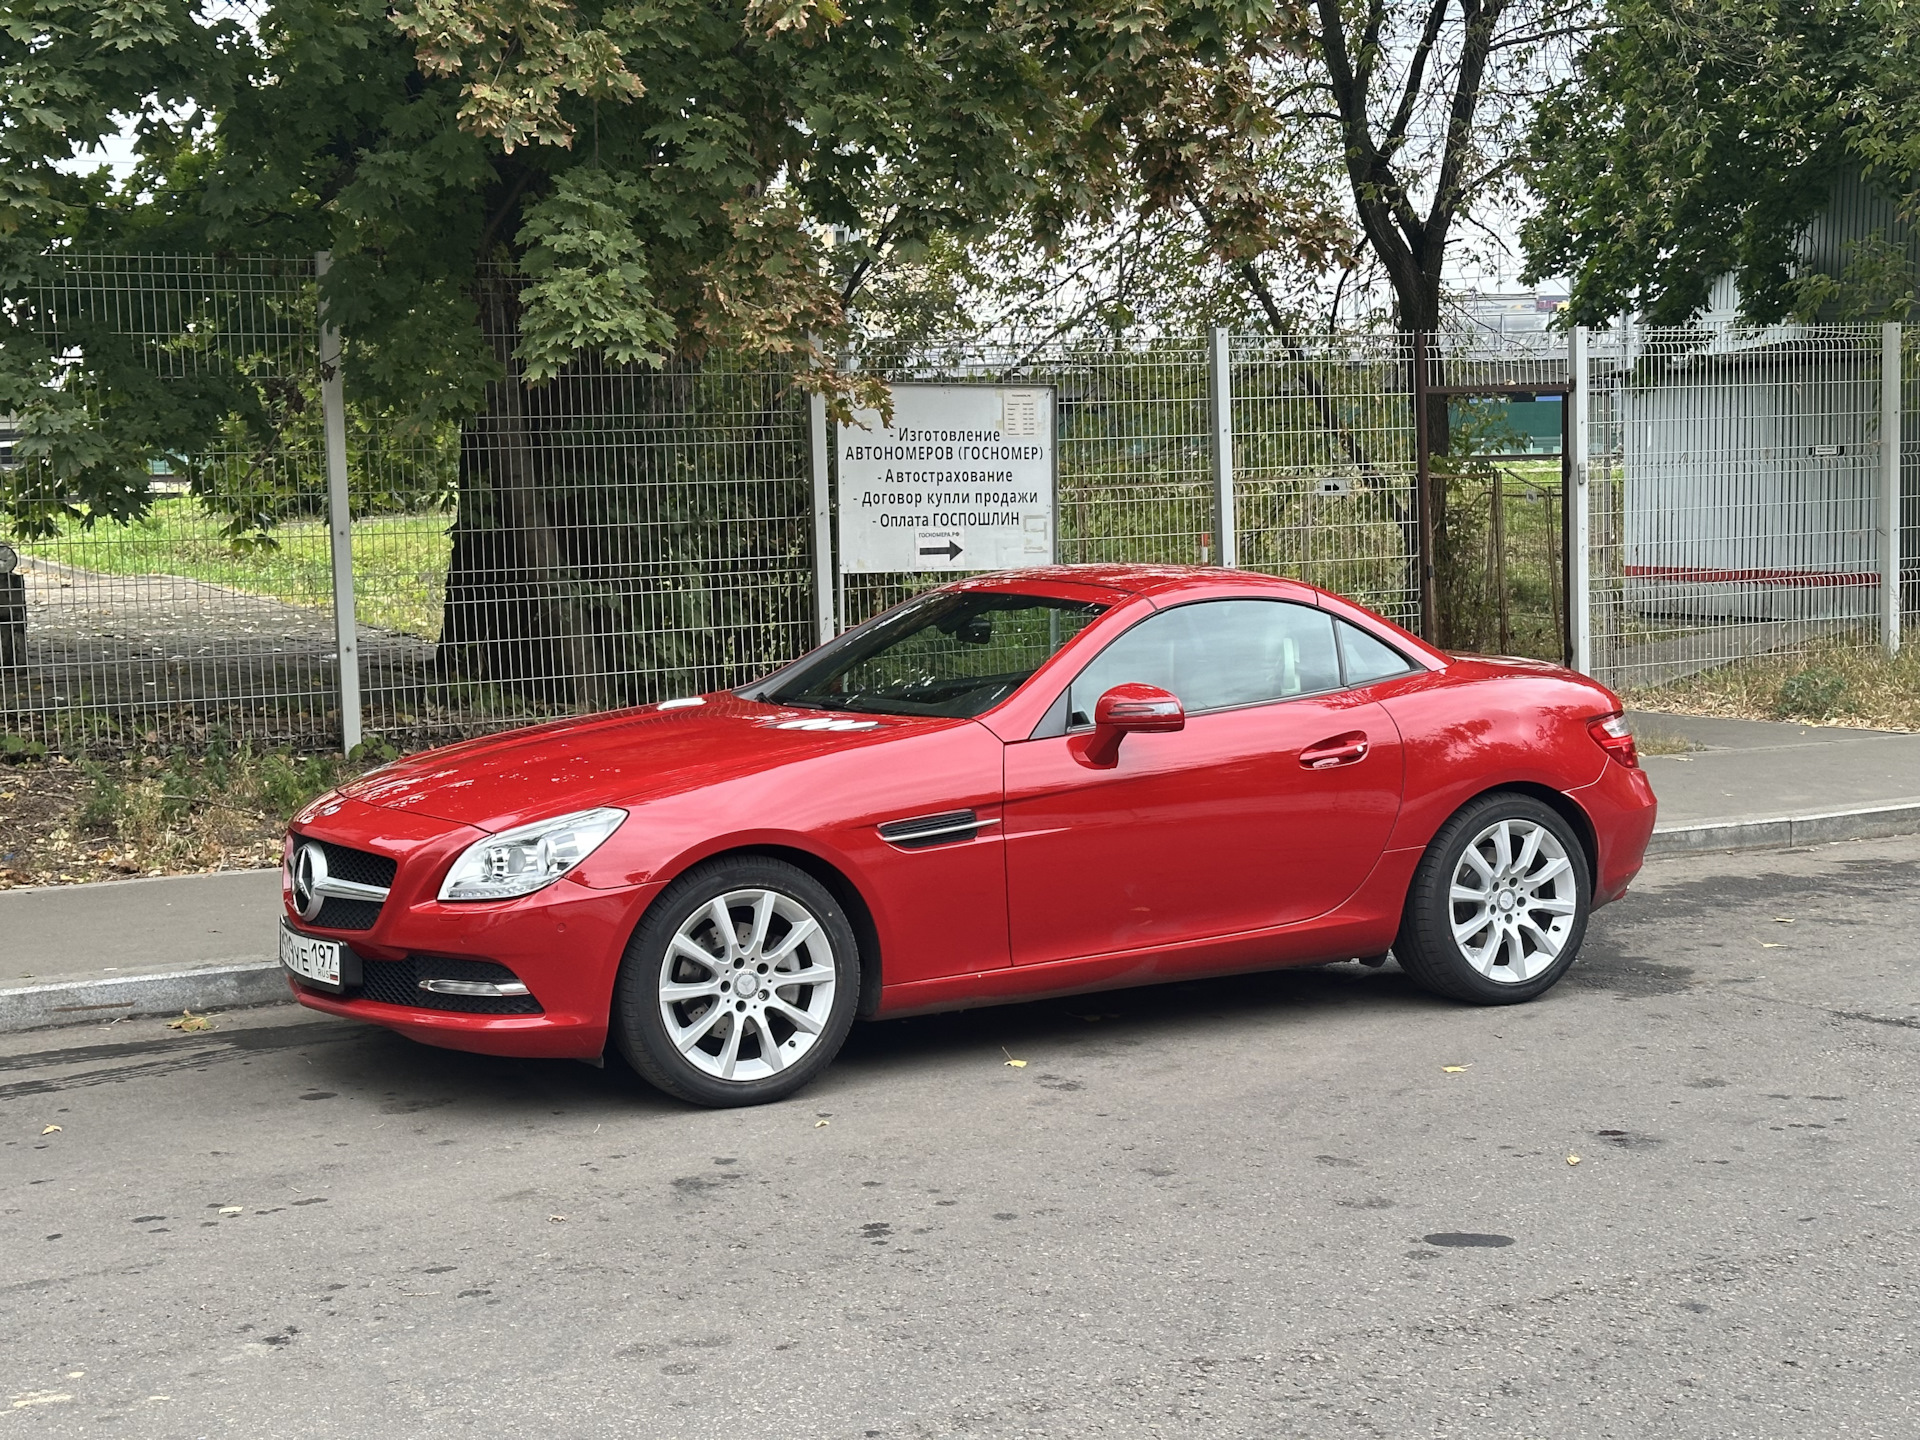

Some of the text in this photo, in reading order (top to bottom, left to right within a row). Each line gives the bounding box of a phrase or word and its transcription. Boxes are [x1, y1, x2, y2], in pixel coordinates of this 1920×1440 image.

[898, 427, 1001, 442] Изготовление
[845, 445, 1043, 461] АВТОНОМЕРОВ (ГОСНОМЕР)
[885, 468, 1013, 486] Автострахование
[862, 491, 922, 508] Договор
[927, 492, 970, 508] купли
[975, 491, 1038, 508] продажи
[880, 513, 929, 528] Оплата
[933, 511, 1020, 527] ГОСПОШЛИН
[311, 942, 334, 970] 197
[317, 968, 330, 979] RUS
